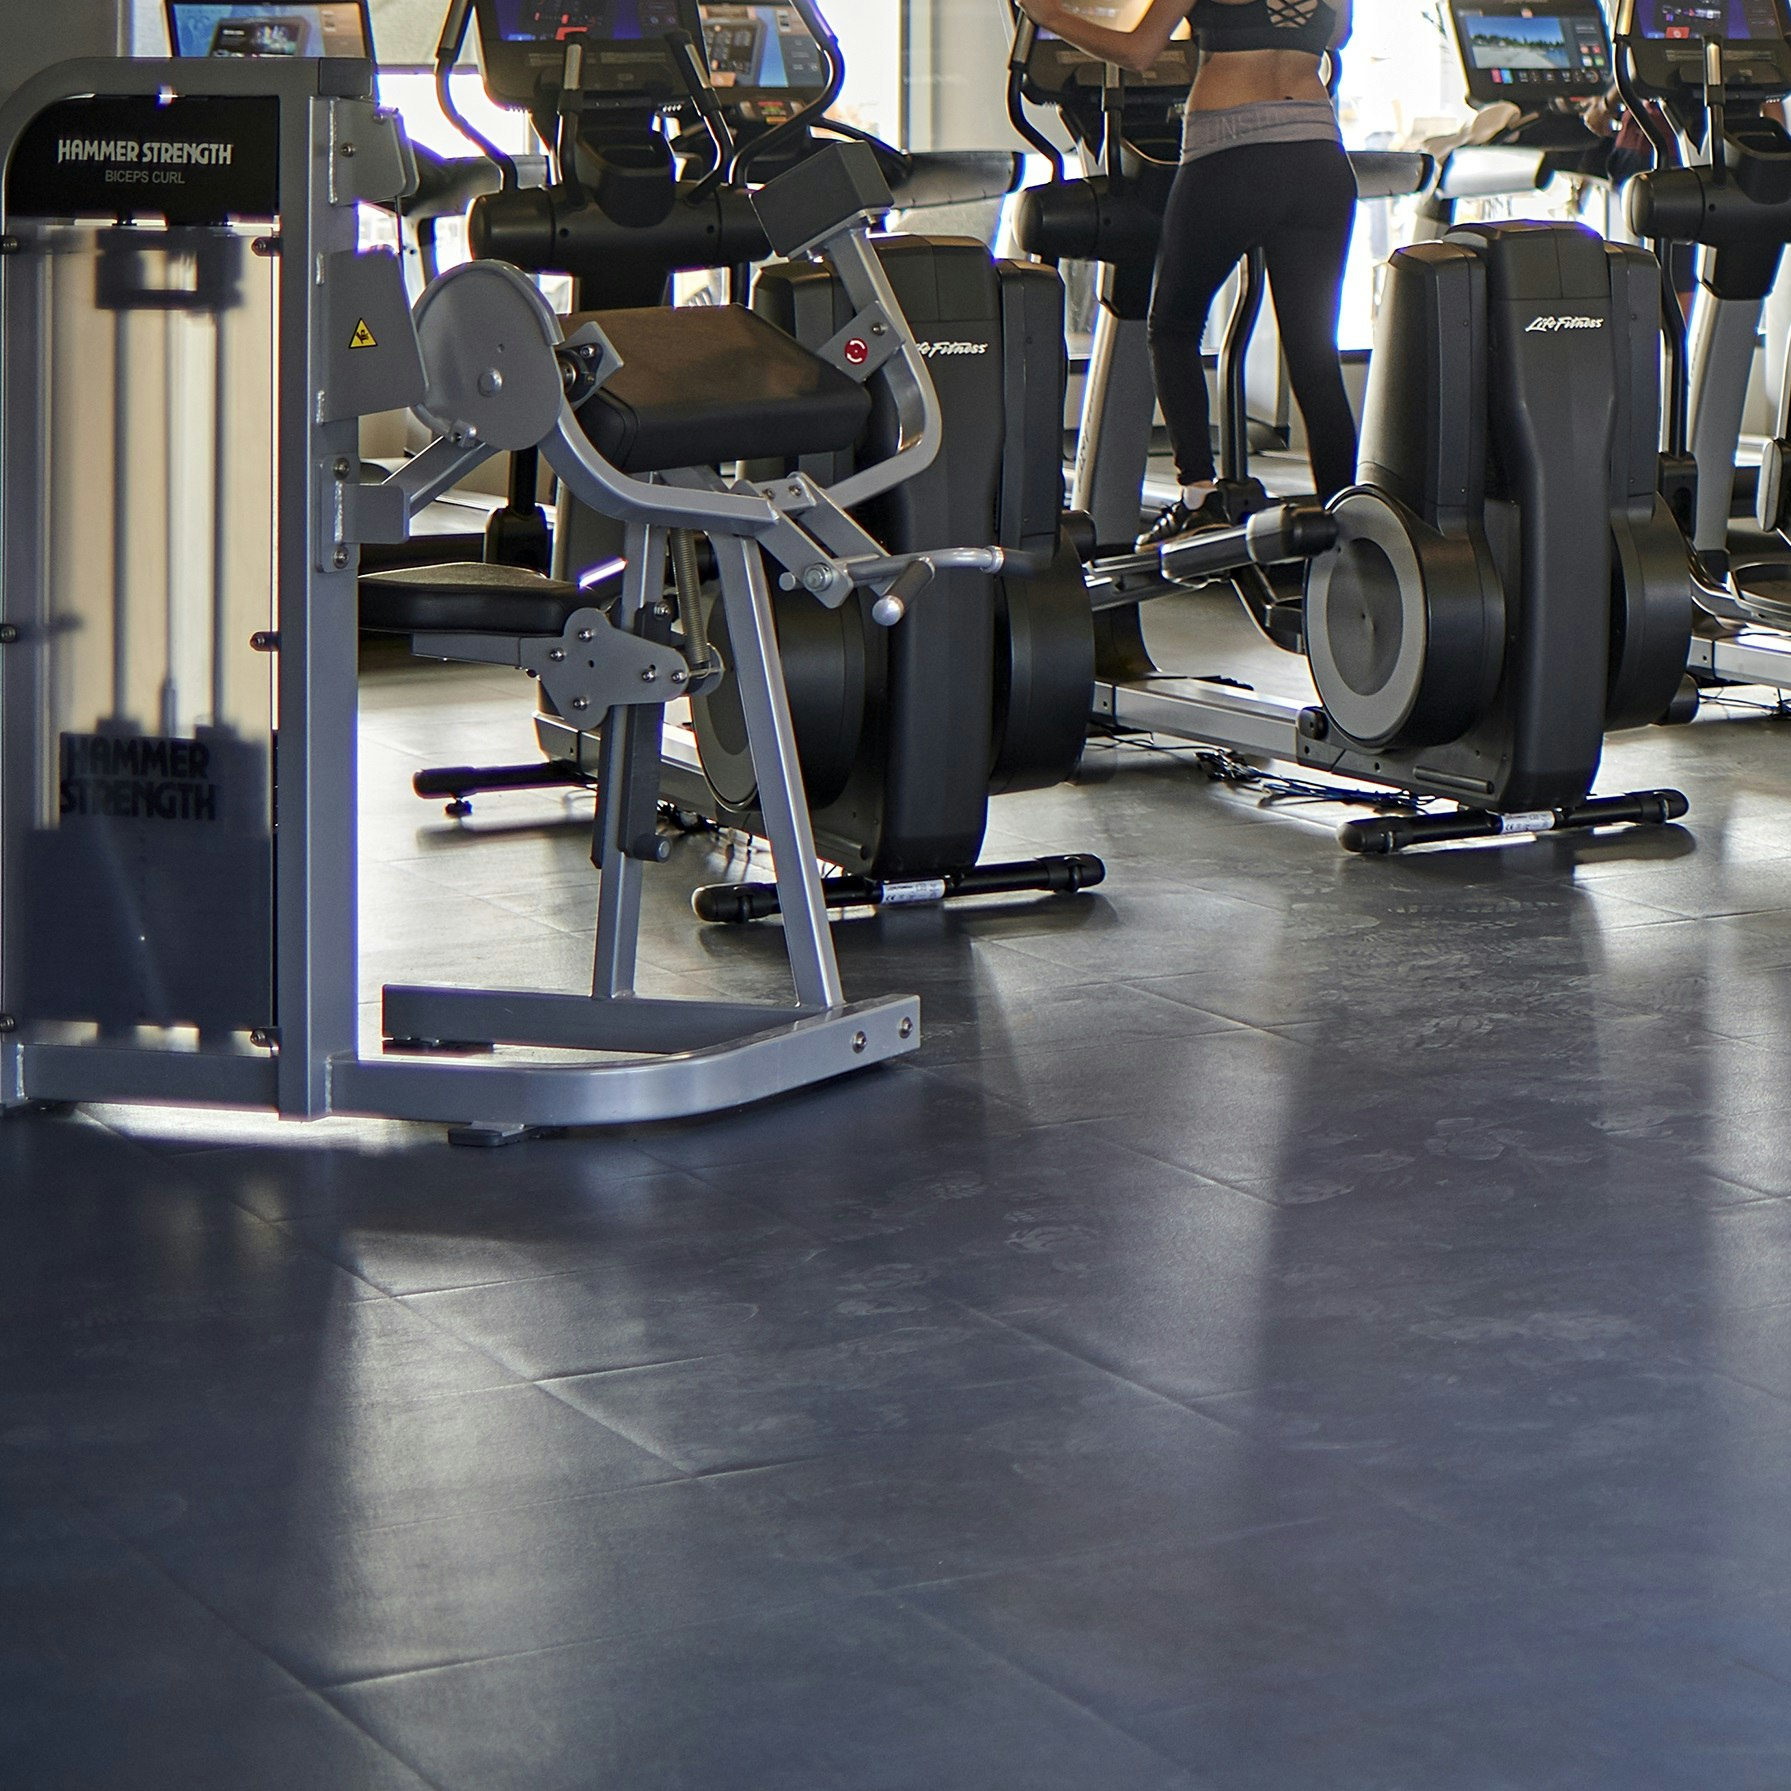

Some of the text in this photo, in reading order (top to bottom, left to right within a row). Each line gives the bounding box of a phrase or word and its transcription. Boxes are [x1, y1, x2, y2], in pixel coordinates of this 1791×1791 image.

[57, 139, 233, 165] HAMMER STRENGTH
[105, 170, 186, 184] BICEPS CURL
[1525, 316, 1604, 332] Life Fitness
[928, 341, 988, 357] Fitness
[65, 737, 211, 781] HAMMER
[60, 779, 217, 821] STRENGTH
